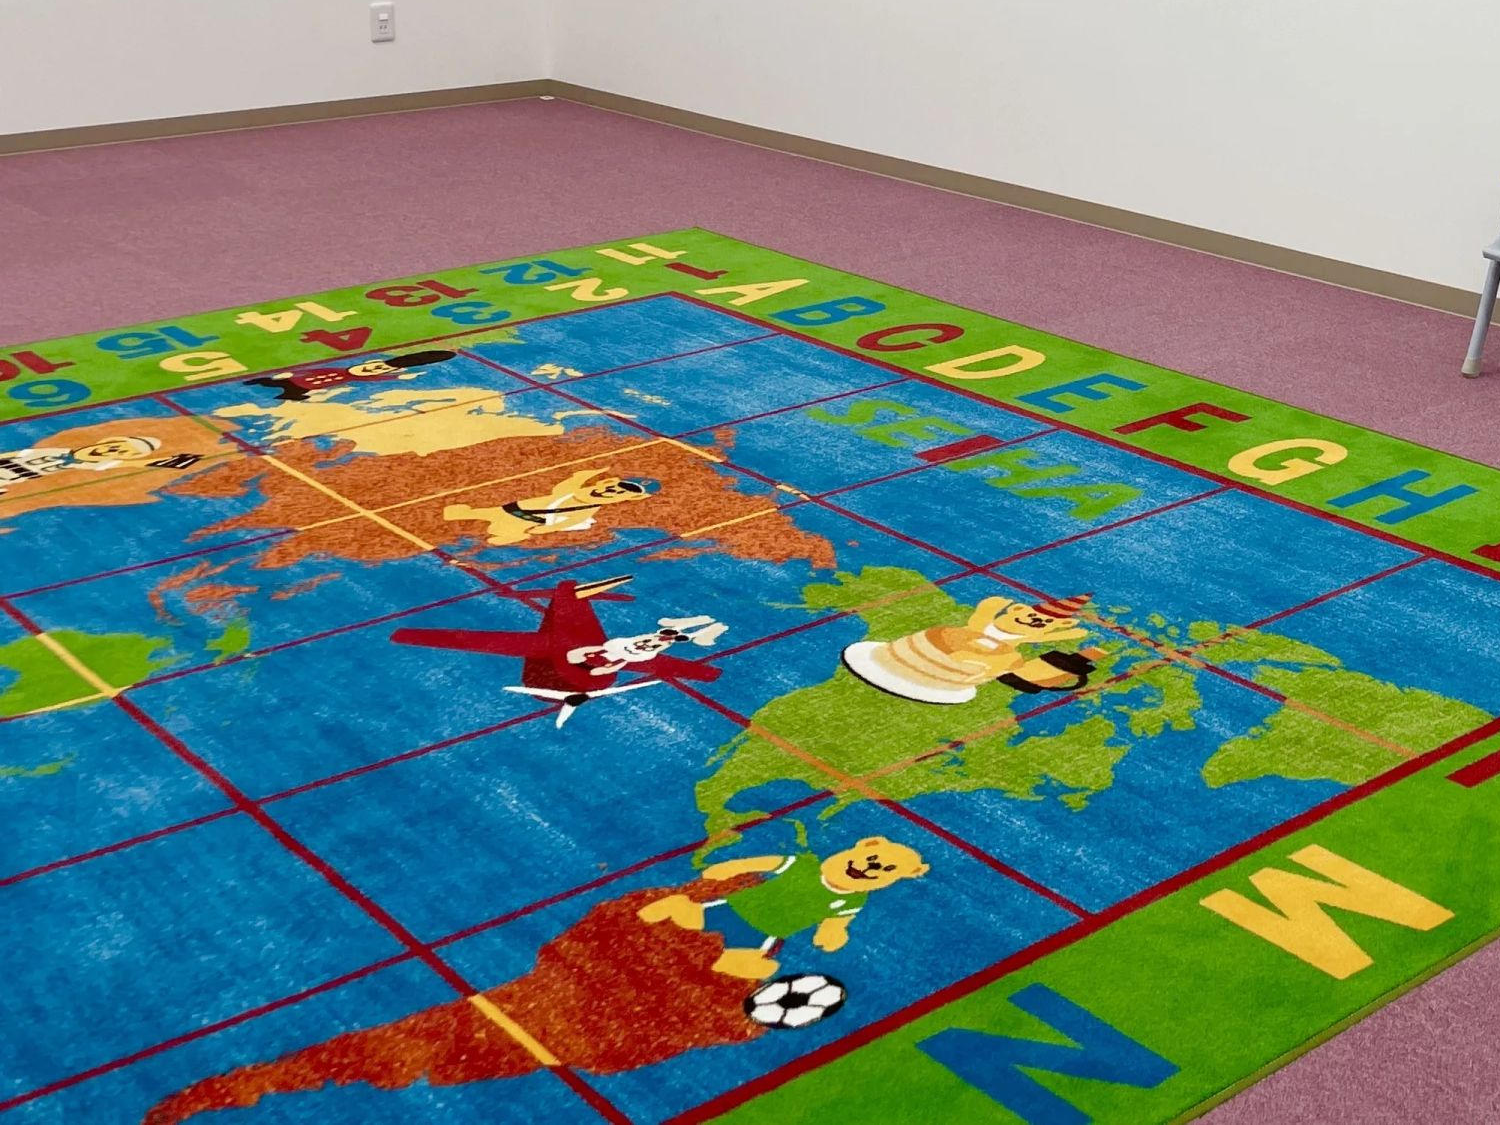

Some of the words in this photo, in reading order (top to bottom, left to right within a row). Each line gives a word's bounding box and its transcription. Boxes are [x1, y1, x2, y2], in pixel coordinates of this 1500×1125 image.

[480, 260, 592, 285] 12
[365, 279, 480, 307] 13
[544, 278, 629, 302] 2
[235, 301, 358, 333] 14
[430, 301, 512, 325] 3
[96, 326, 220, 359] 15
[299, 327, 373, 352] 4
[0, 351, 75, 382] 1
[159, 351, 248, 381] 5
[694, 278, 810, 306] A
[768, 296, 886, 326] B
[857, 323, 964, 352] C
[924, 345, 1046, 379] D
[1014, 372, 1149, 413] E
[1112, 402, 1253, 436] F
[1227, 438, 1349, 486] G
[1327, 469, 1479, 525] H
[805, 398, 1145, 520] SEIHA
[1199, 843, 1456, 980] M
[914, 982, 1181, 1125] N
